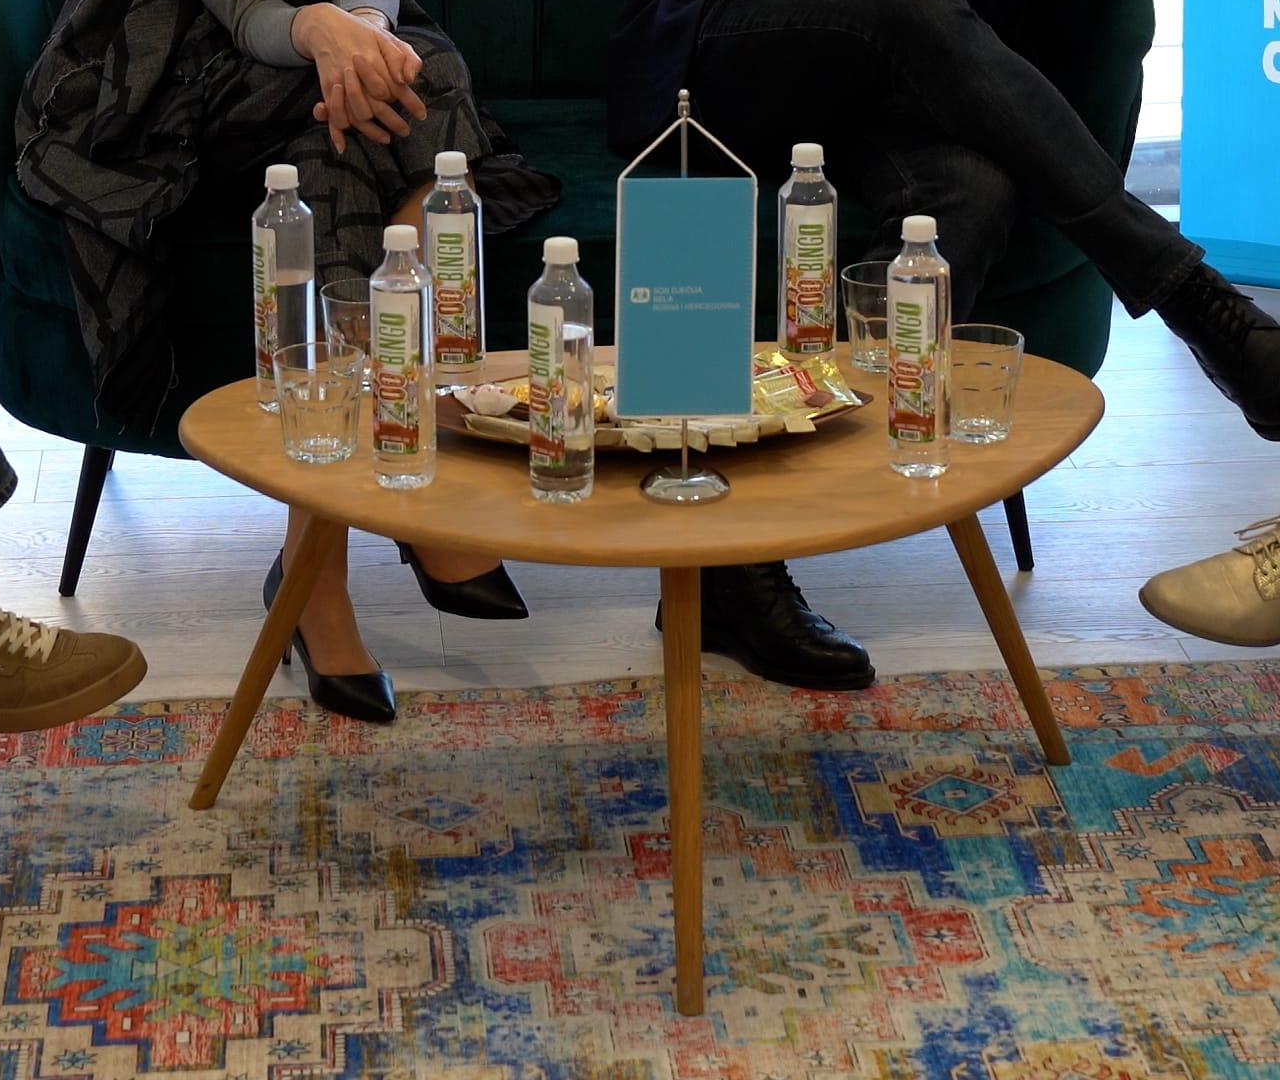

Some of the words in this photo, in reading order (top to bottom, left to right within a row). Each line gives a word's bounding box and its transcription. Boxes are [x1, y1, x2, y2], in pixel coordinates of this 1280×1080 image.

[436, 231, 465, 282] BINGO
[797, 223, 825, 272] BINGO
[435, 287, 467, 340] ZOO
[795, 278, 826, 329] ZOO
[895, 300, 922, 355] BINGO
[378, 311, 407, 366] BINGO
[529, 321, 551, 379] BINGO
[377, 371, 409, 429] ZOO
[894, 359, 925, 418] ZOO
